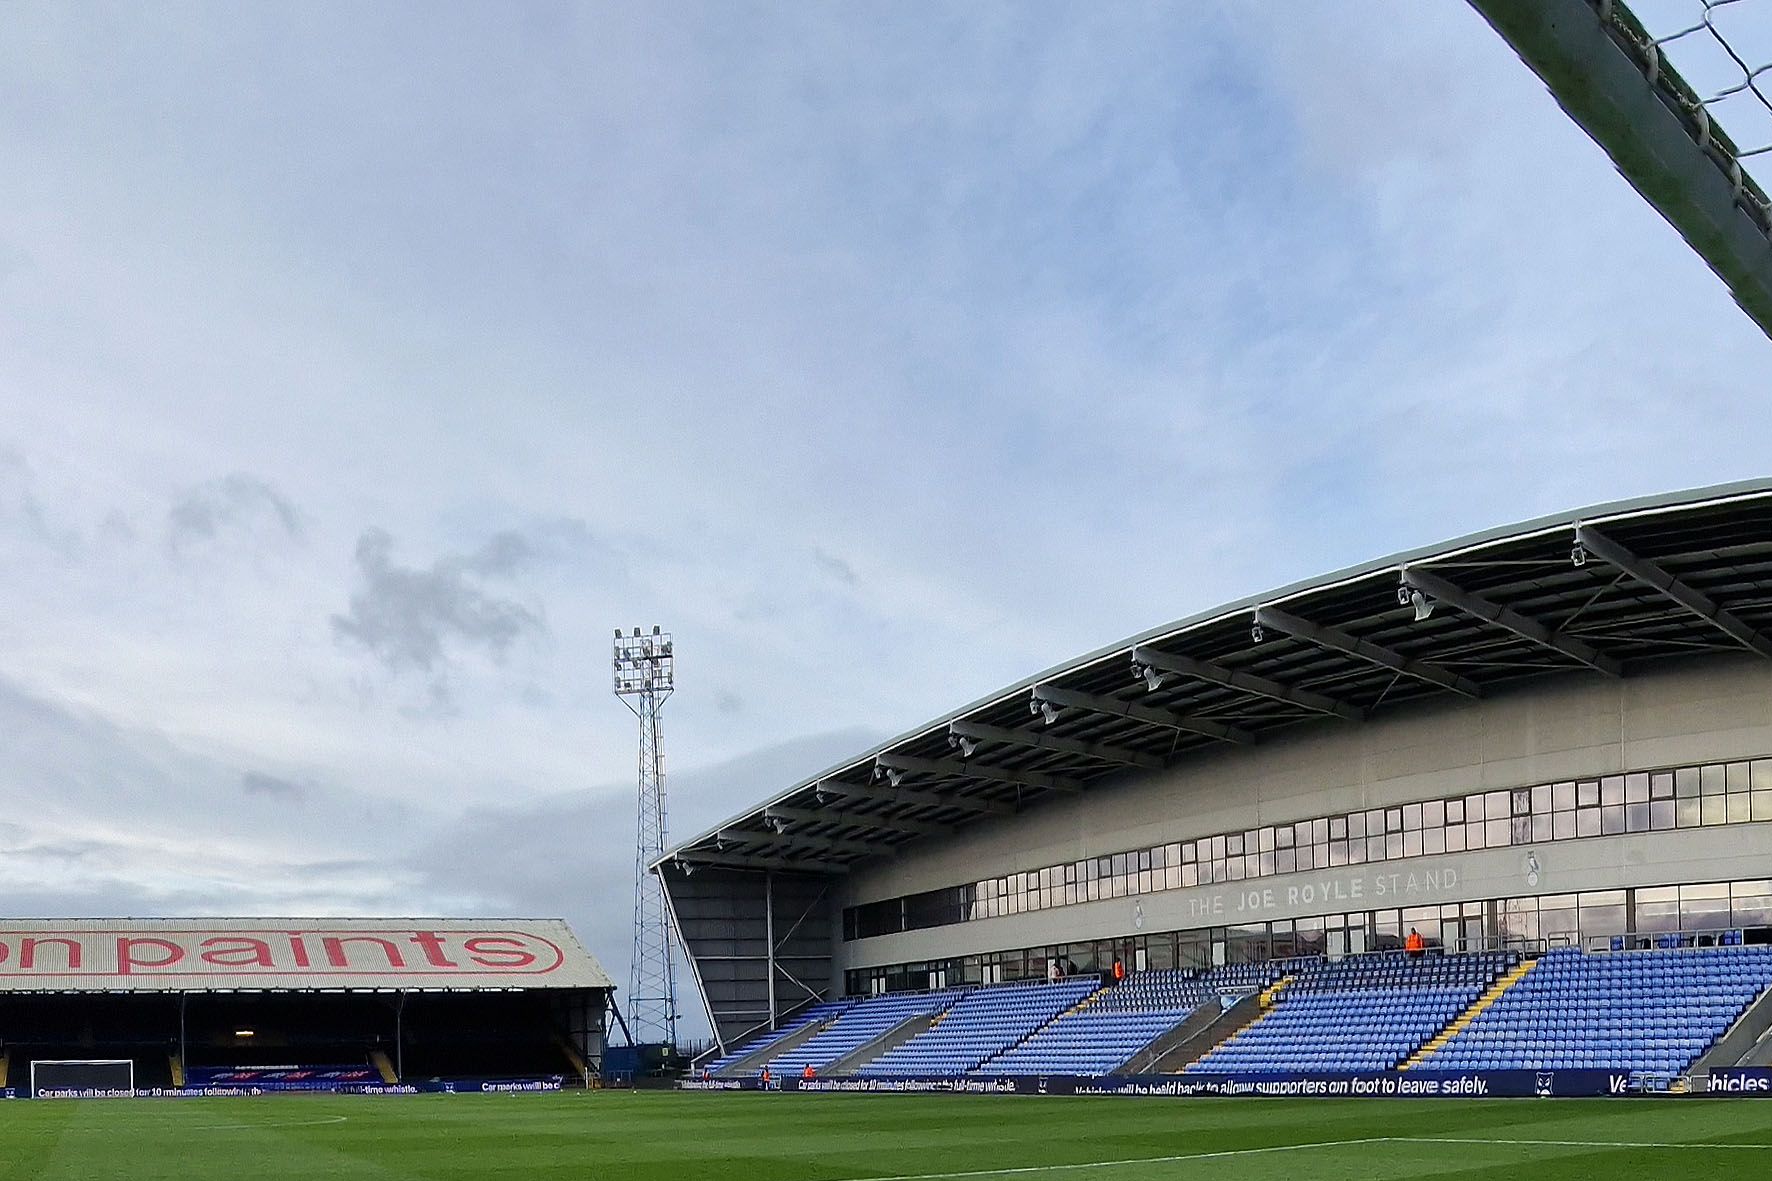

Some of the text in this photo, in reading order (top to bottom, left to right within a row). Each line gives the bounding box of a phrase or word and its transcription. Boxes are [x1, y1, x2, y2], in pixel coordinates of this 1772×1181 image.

[1189, 868, 1458, 918] THE JOE ROYLE STAND
[0, 930, 537, 975] n paints
[1351, 1077, 1380, 1094] foot
[1381, 1077, 1396, 1094] to
[1397, 1076, 1439, 1094] leave
[1441, 1075, 1489, 1095] safely.
